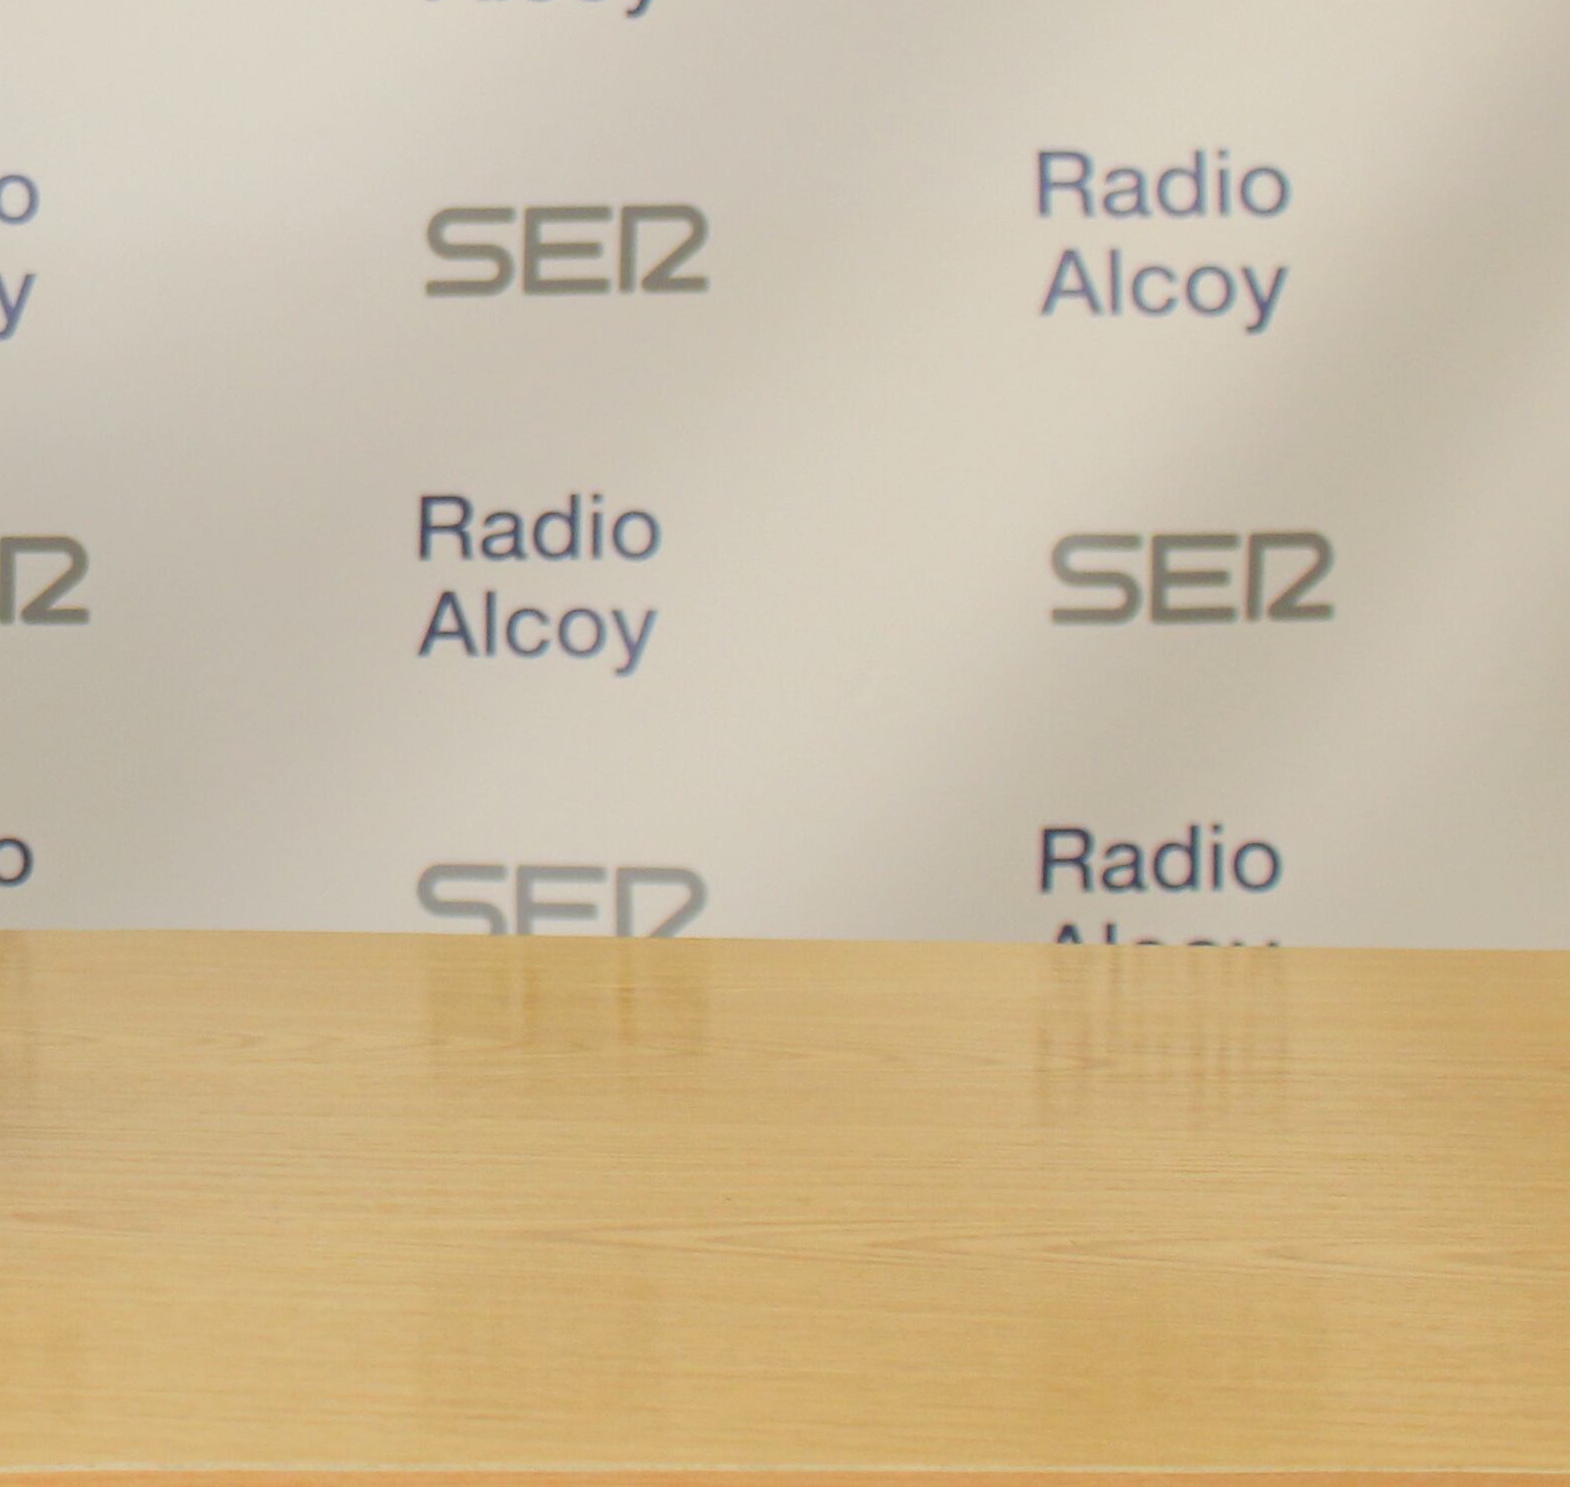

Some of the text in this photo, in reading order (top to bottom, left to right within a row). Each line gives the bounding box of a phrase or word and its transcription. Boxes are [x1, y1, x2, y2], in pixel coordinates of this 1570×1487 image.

[1036, 149, 1290, 218] Radio
[425, 204, 708, 297] SER
[1040, 248, 1287, 334] Alcoy
[418, 493, 660, 561] Radio
[1051, 530, 1333, 624] SER
[418, 590, 656, 676] Alcoy
[1039, 824, 1281, 893] Radio
